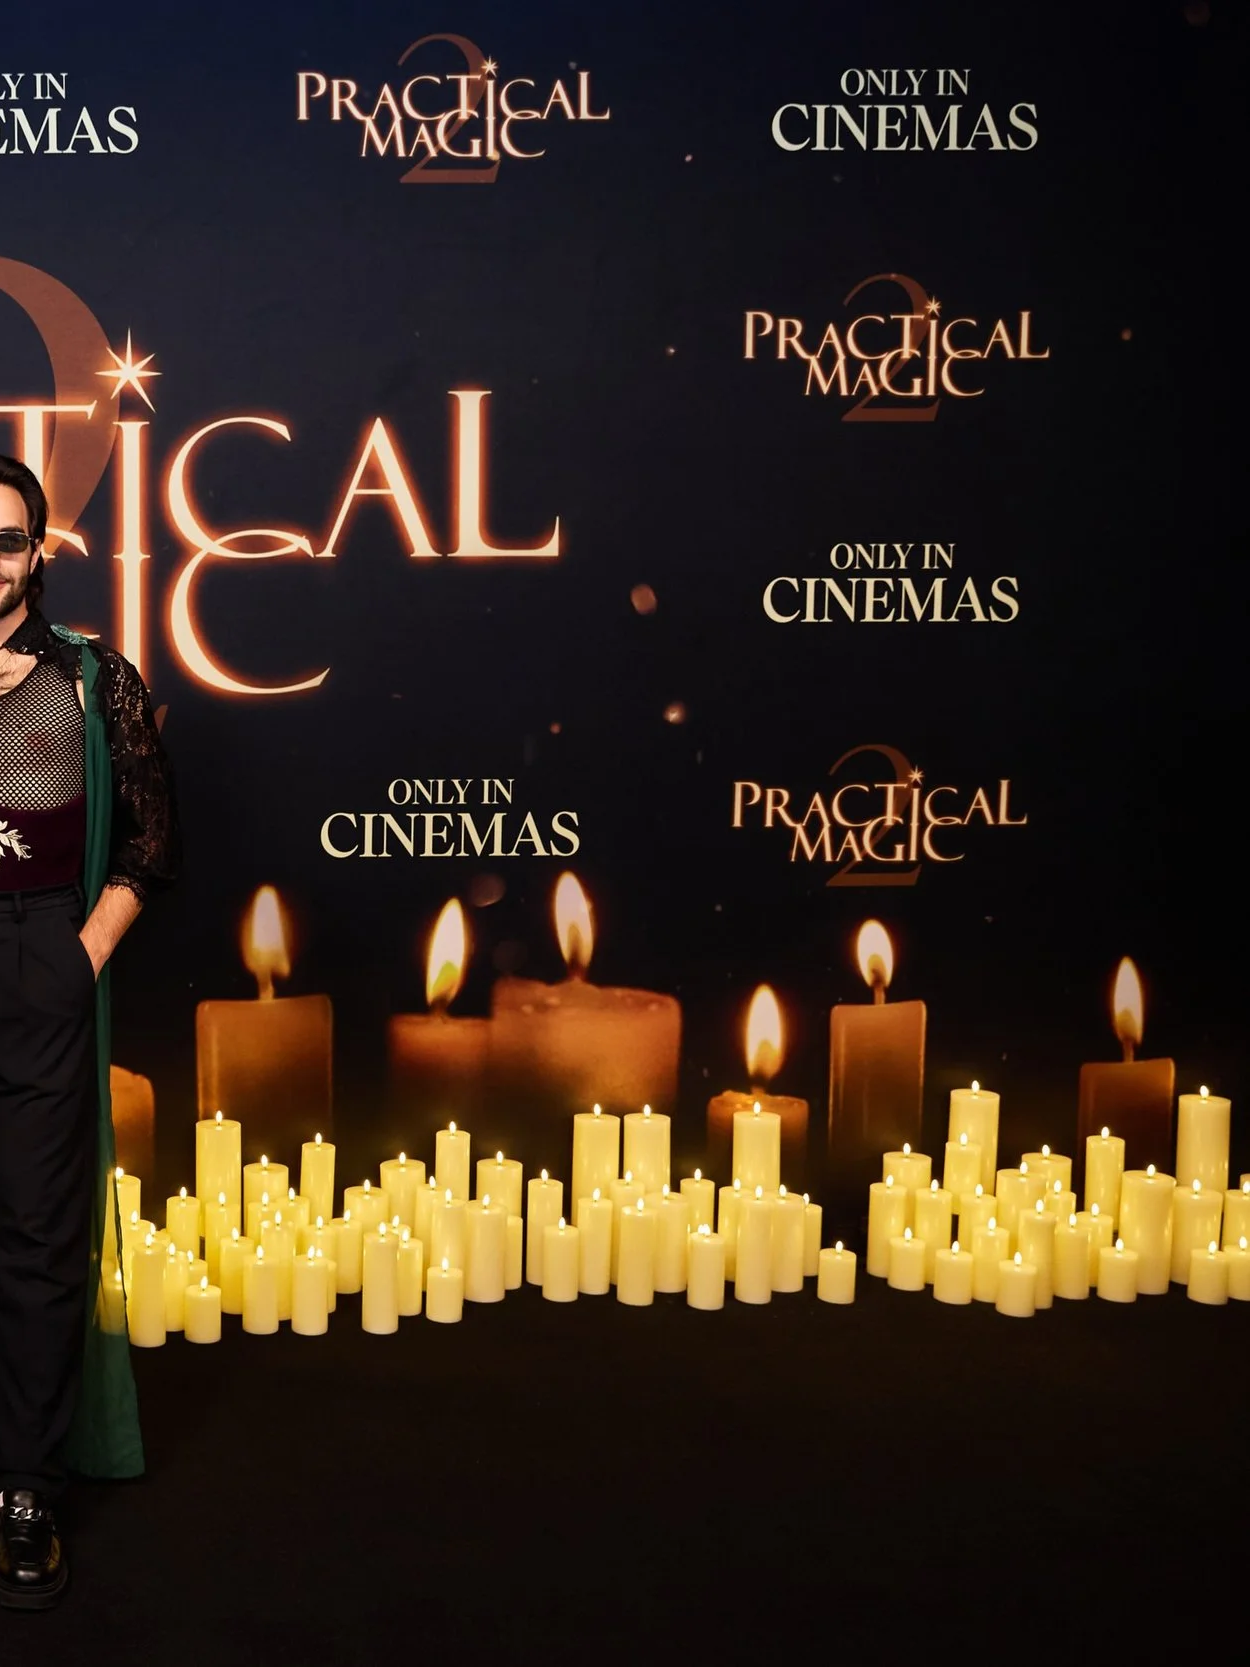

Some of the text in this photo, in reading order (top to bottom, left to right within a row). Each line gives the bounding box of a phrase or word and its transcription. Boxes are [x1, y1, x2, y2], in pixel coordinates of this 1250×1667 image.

[34, 72, 68, 100] IN
[296, 71, 611, 121] PRACTICAL
[840, 69, 970, 96] ONLY IN
[361, 109, 546, 158] MAGIC
[771, 103, 1038, 152] CINEMAS
[744, 311, 1050, 360] PRACTICAL
[805, 349, 985, 397] MAGIC
[830, 543, 955, 570] ONLY IN
[762, 577, 1019, 623] CINEMAS
[388, 779, 515, 805] ONLY IN
[731, 779, 1028, 828] PRACTICAL
[320, 811, 580, 859] CINEMAS
[790, 815, 966, 862] MAGIC
